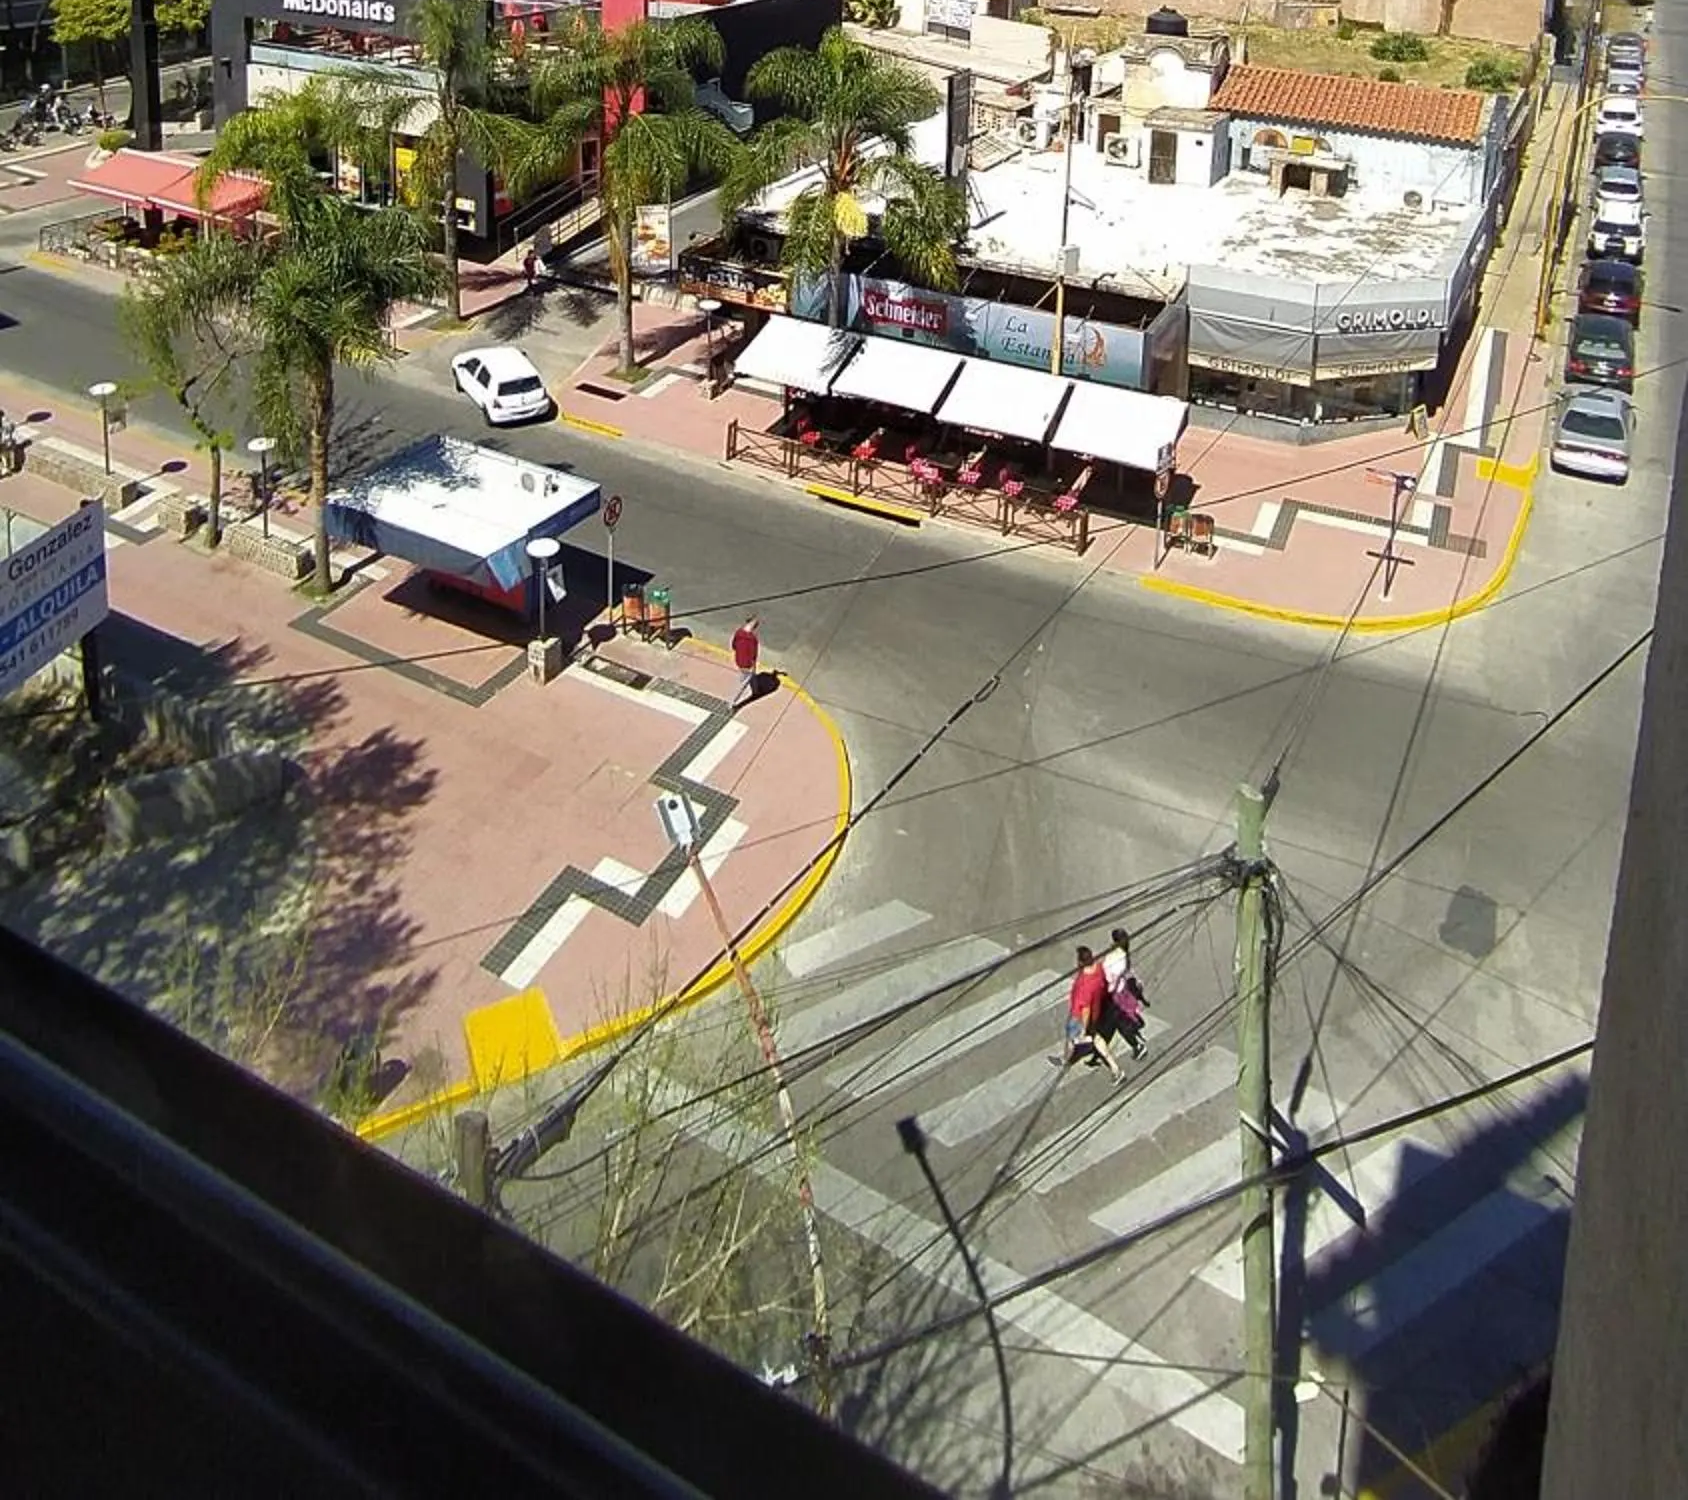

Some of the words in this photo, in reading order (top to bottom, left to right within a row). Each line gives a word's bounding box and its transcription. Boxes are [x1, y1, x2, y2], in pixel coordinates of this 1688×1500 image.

[866, 295, 943, 330] Schneider
[1006, 316, 1027, 333] La
[1337, 308, 1437, 333] GRIMOLDI
[1001, 337, 1075, 365] Estana
[8, 513, 93, 581] Gonzalez
[15, 565, 99, 641] ALQUILA
